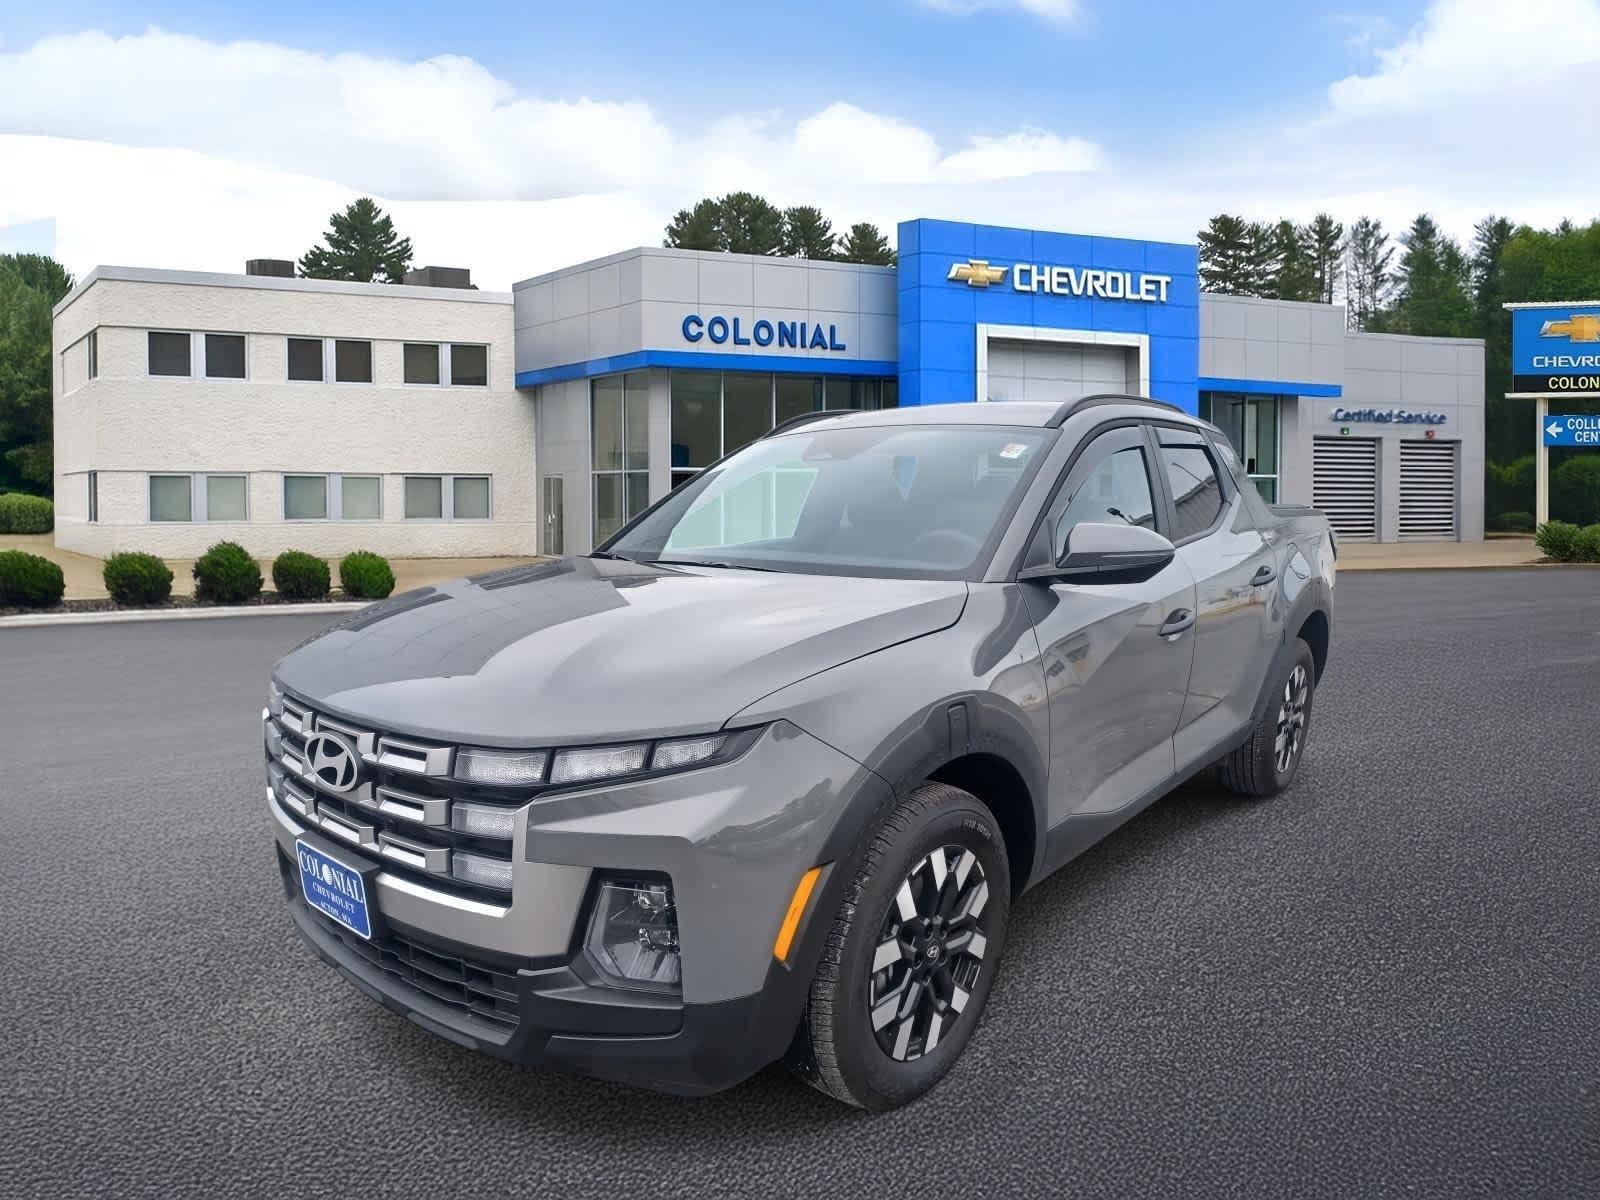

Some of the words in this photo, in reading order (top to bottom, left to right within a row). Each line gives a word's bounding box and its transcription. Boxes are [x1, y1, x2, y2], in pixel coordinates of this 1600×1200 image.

[1013, 263, 1172, 302] CHEVROLET
[682, 314, 846, 351] COLONIAL
[1548, 376, 1600, 389] COLON
[1332, 408, 1392, 423] Certified
[1394, 410, 1447, 424] Service
[1575, 431, 1600, 443] CEN
[299, 850, 364, 904] COLONIAL
[312, 881, 355, 914] CHEVROLET
